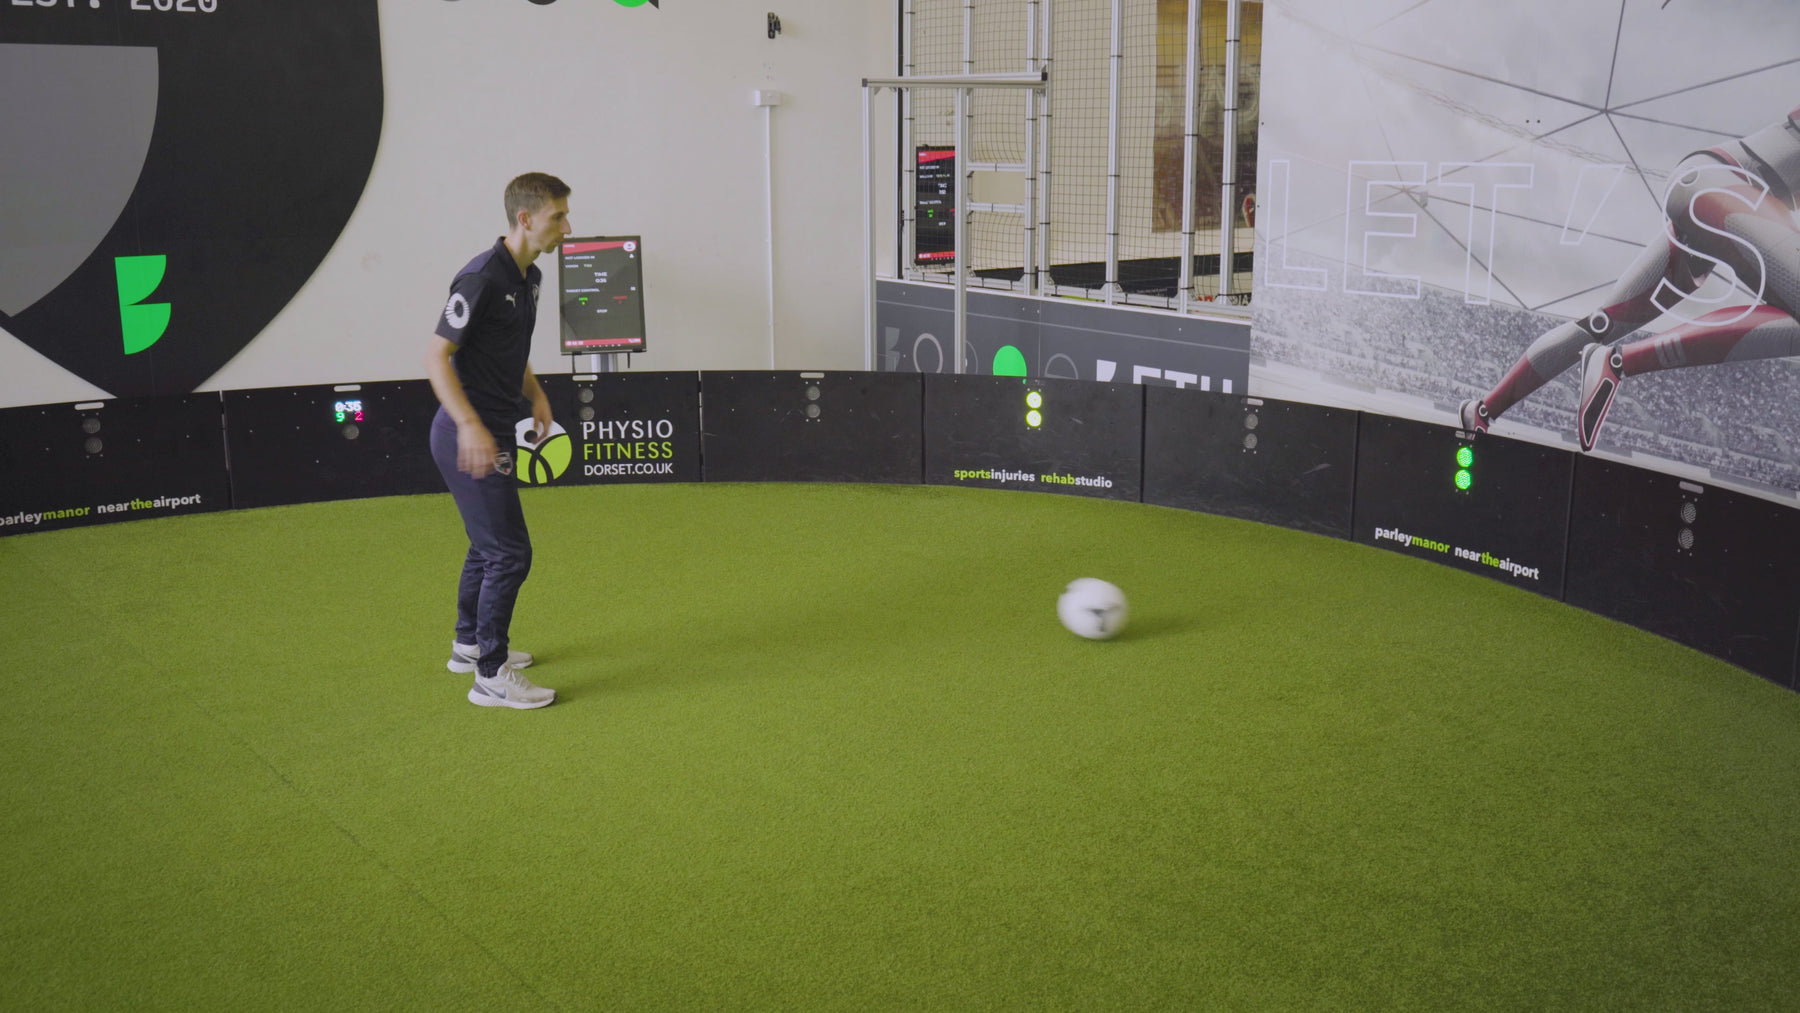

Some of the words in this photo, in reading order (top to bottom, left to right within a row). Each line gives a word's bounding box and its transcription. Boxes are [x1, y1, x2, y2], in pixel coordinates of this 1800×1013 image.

[1265, 160, 1770, 326] LET'S
[335, 411, 345, 422] 9
[354, 411, 365, 422] 2
[582, 419, 674, 440] PHYSIO
[583, 441, 674, 461] FITNESS
[584, 462, 674, 476] DORSET.CO.UK
[954, 469, 1035, 483] sportsinjuries
[1041, 473, 1113, 488] rehabstudio
[97, 493, 201, 514] neartheairport
[1375, 527, 1450, 553] parleymanor
[1455, 546, 1539, 580] neartheairport
